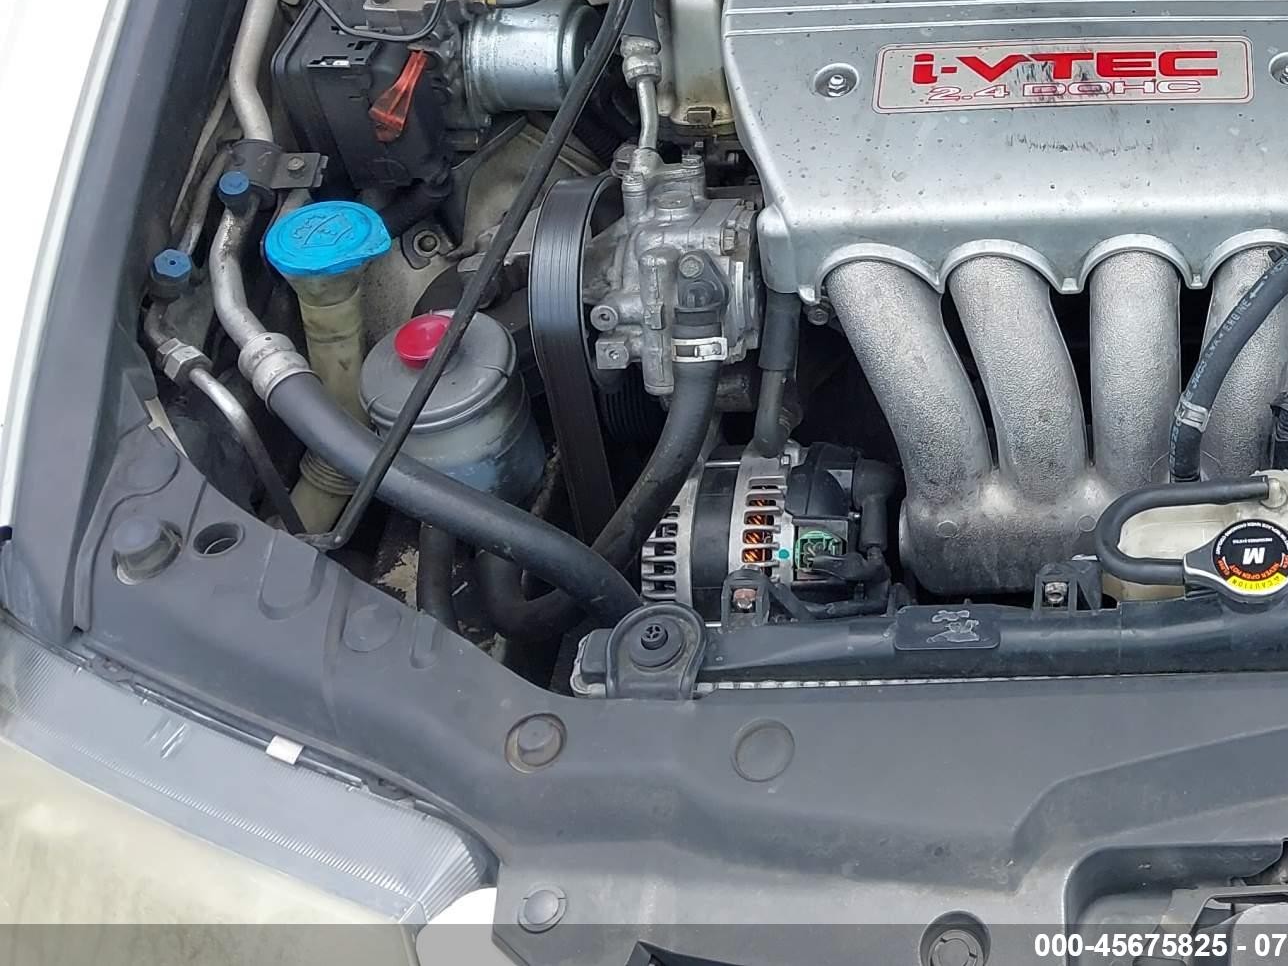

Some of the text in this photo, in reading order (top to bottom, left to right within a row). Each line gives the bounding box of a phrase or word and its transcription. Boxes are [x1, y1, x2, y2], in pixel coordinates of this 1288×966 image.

[912, 50, 1219, 84] i-VTEC
[927, 79, 1201, 101] 2.4 DOHC
[1242, 547, 1266, 565] M
[1230, 562, 1280, 580] NEVER OPEN HOT
[1232, 577, 1274, 590] CAUTION
